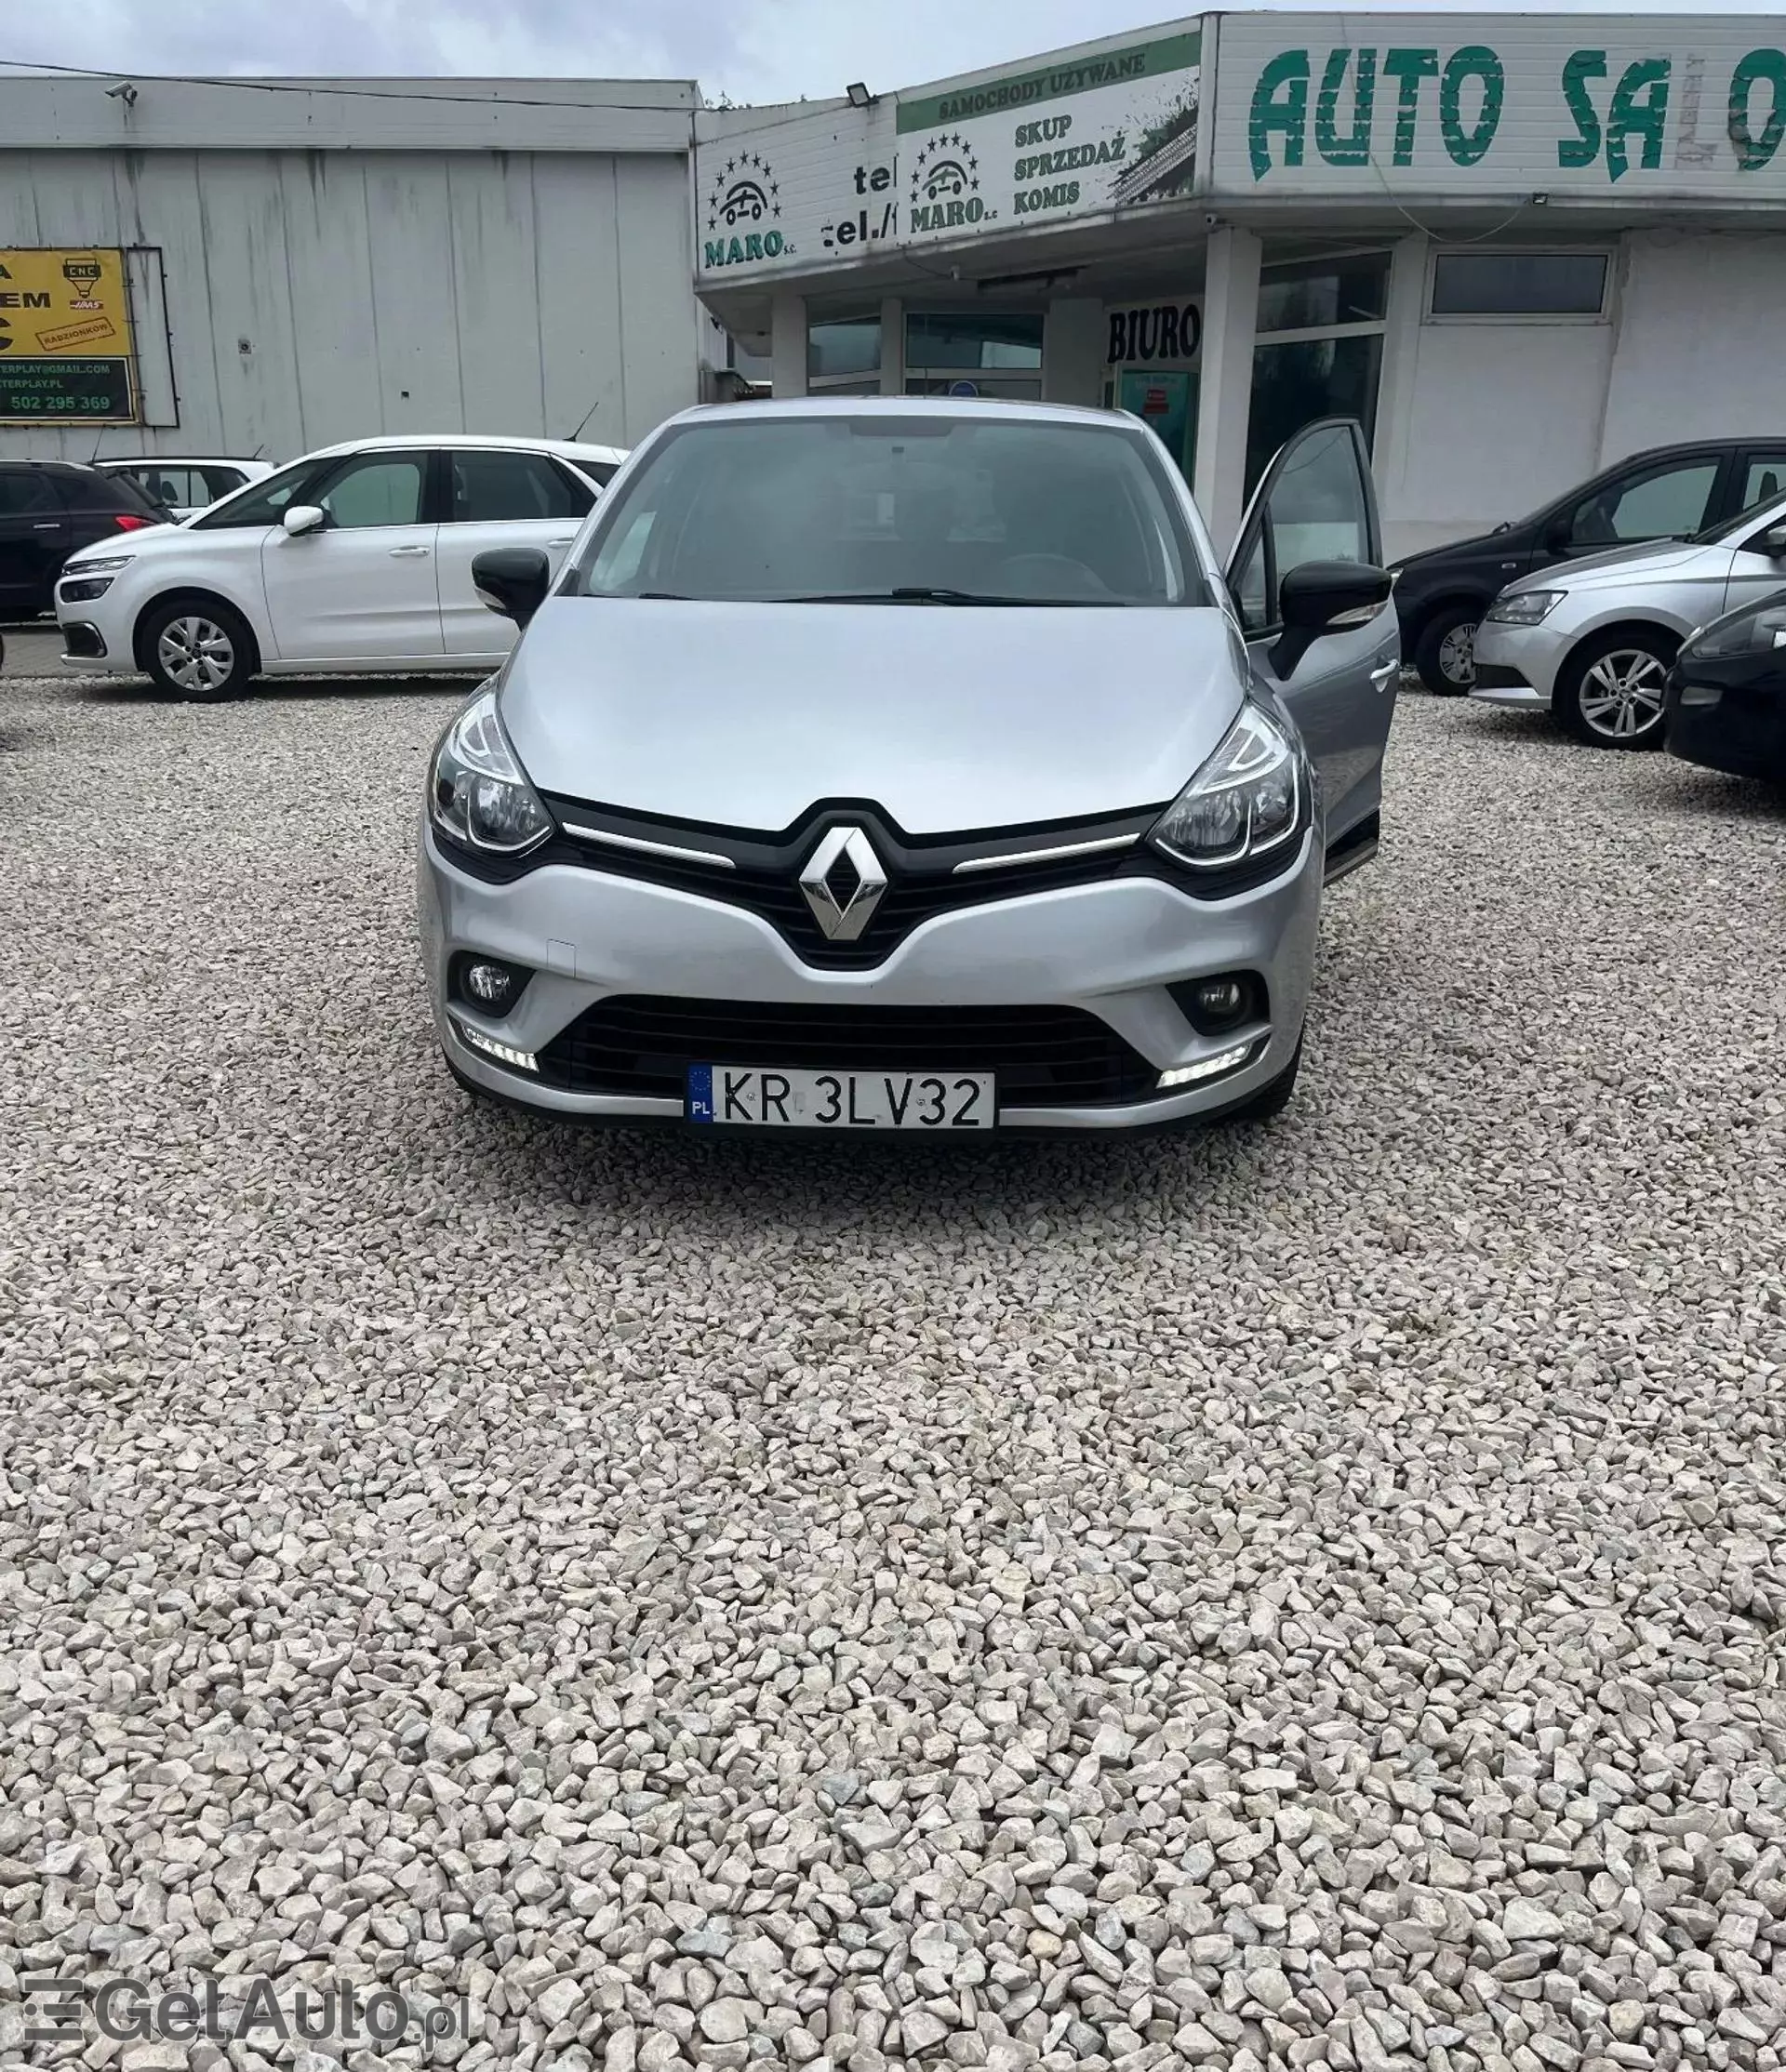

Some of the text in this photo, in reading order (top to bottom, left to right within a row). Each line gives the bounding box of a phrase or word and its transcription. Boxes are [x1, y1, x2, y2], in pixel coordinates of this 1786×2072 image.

[939, 77, 1046, 120] SAMOCHODY
[1248, 46, 1504, 183] AUTO
[1015, 114, 1073, 148] SKUP
[1014, 130, 1126, 181] SPRZEDAŻ
[910, 197, 983, 233] MARO
[1013, 180, 1080, 215] KOMIS
[704, 230, 783, 269] MARO
[69, 266, 96, 276] CNC
[1107, 303, 1200, 364] BIURO
[0, 379, 64, 389] TERPLAY.PL
[11, 396, 111, 410] 502 295 369
[692, 1101, 711, 1115] PL
[725, 1072, 980, 1126] KR 3LV32
